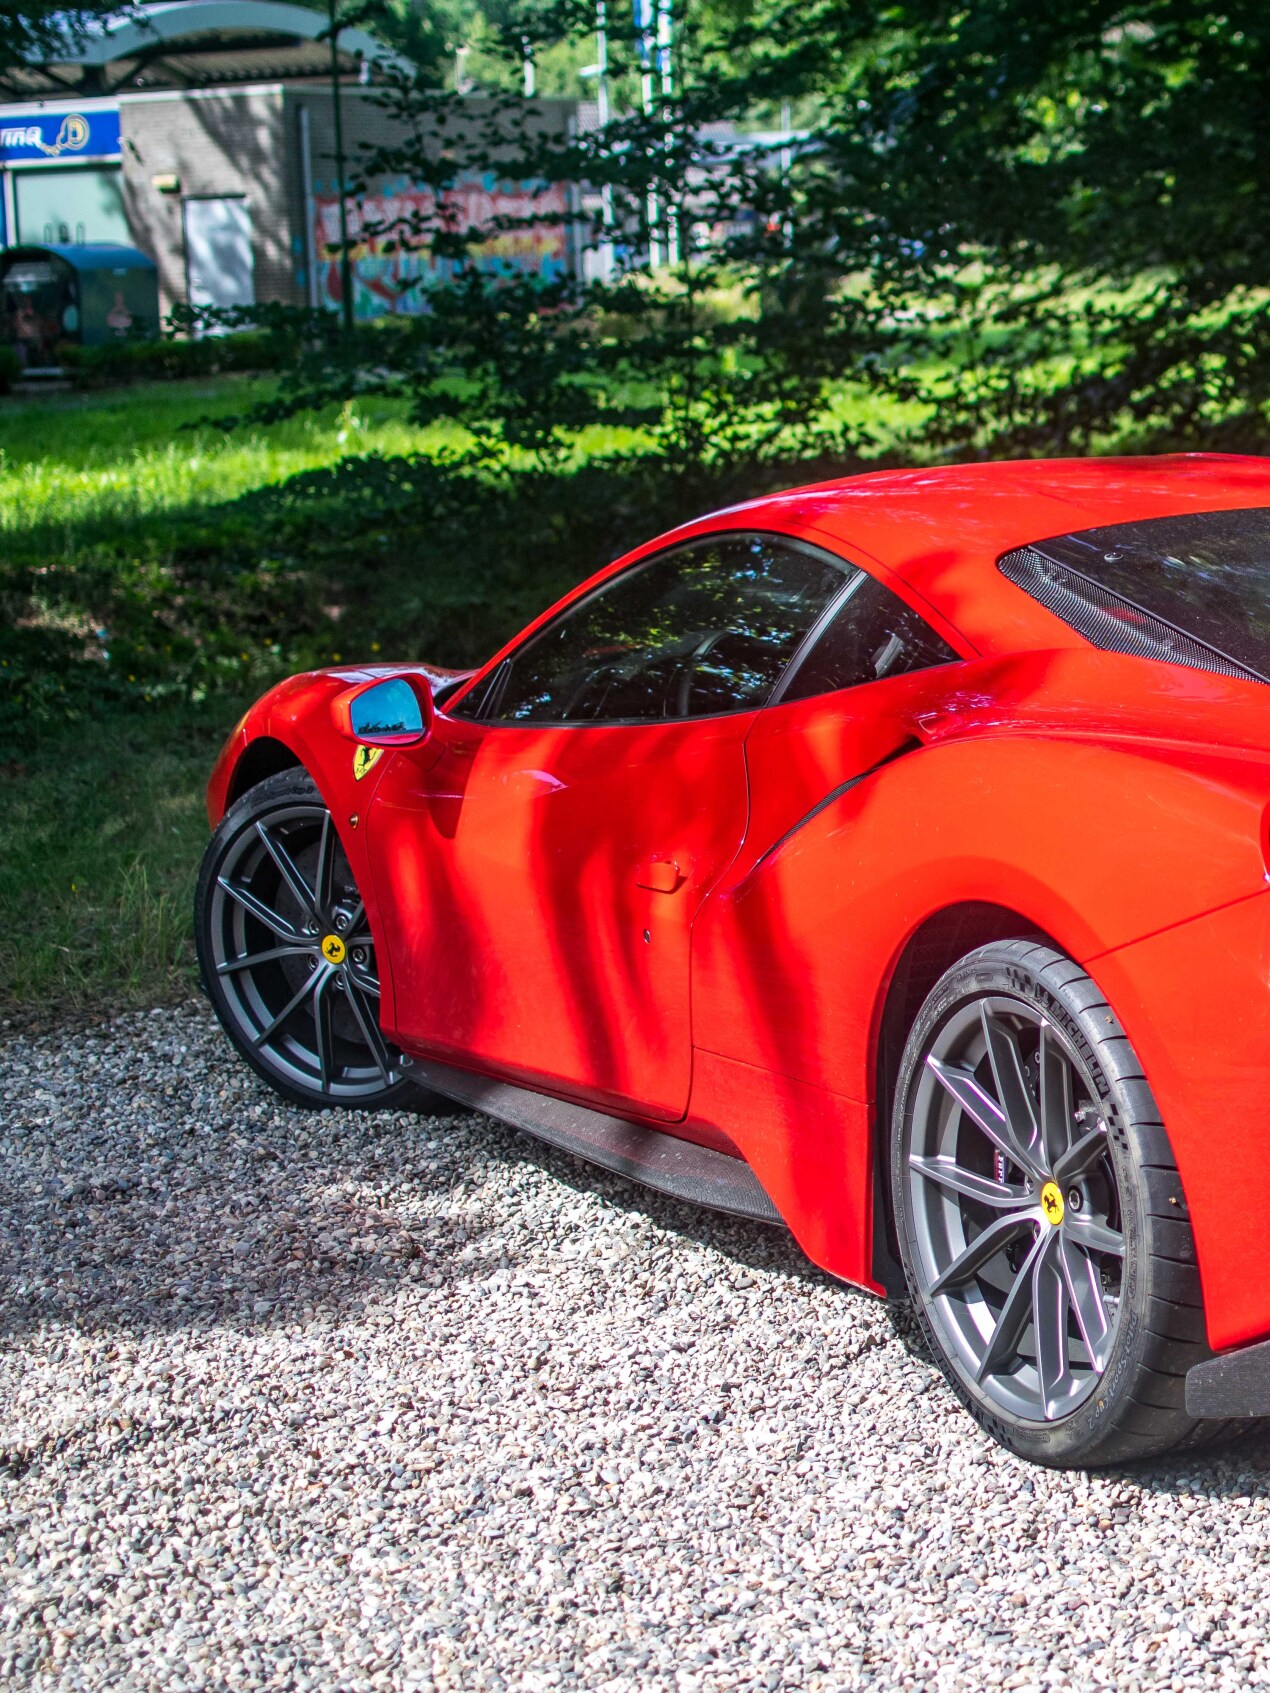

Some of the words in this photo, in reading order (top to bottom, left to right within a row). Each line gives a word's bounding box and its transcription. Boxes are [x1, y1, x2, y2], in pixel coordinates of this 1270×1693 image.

[1050, 1000, 1110, 1097] MICHELIN
[1123, 1309, 1138, 1355] Pilot
[1107, 1354, 1127, 1398] Sport
[1094, 1396, 1109, 1419] Cup
